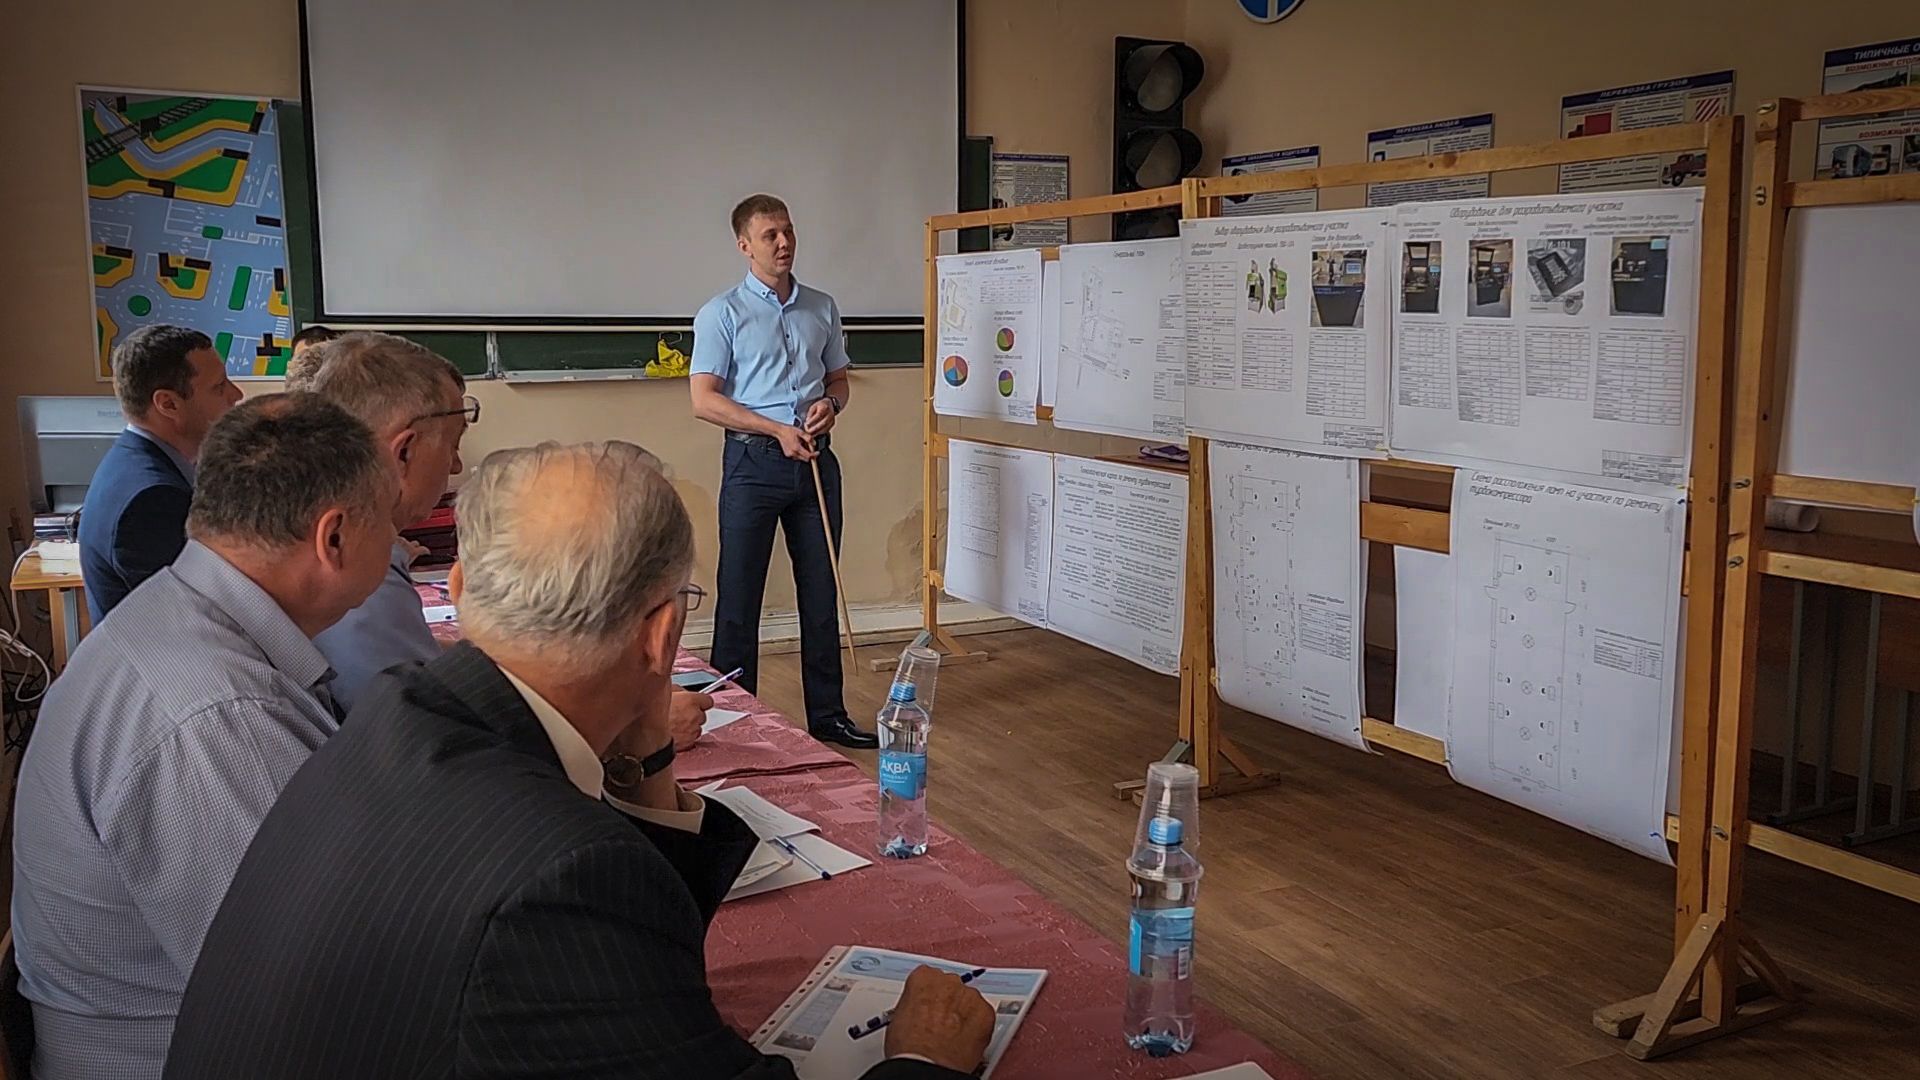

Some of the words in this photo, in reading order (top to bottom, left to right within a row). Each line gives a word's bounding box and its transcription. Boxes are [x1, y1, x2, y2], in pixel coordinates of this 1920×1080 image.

[1854, 44, 1911, 60] ТИПИЧНЫЕ
[1600, 84, 1651, 97] ПЕРЕВОЗКА
[1624, 498, 1664, 514] ремонту
[881, 758, 911, 775] АКВА
